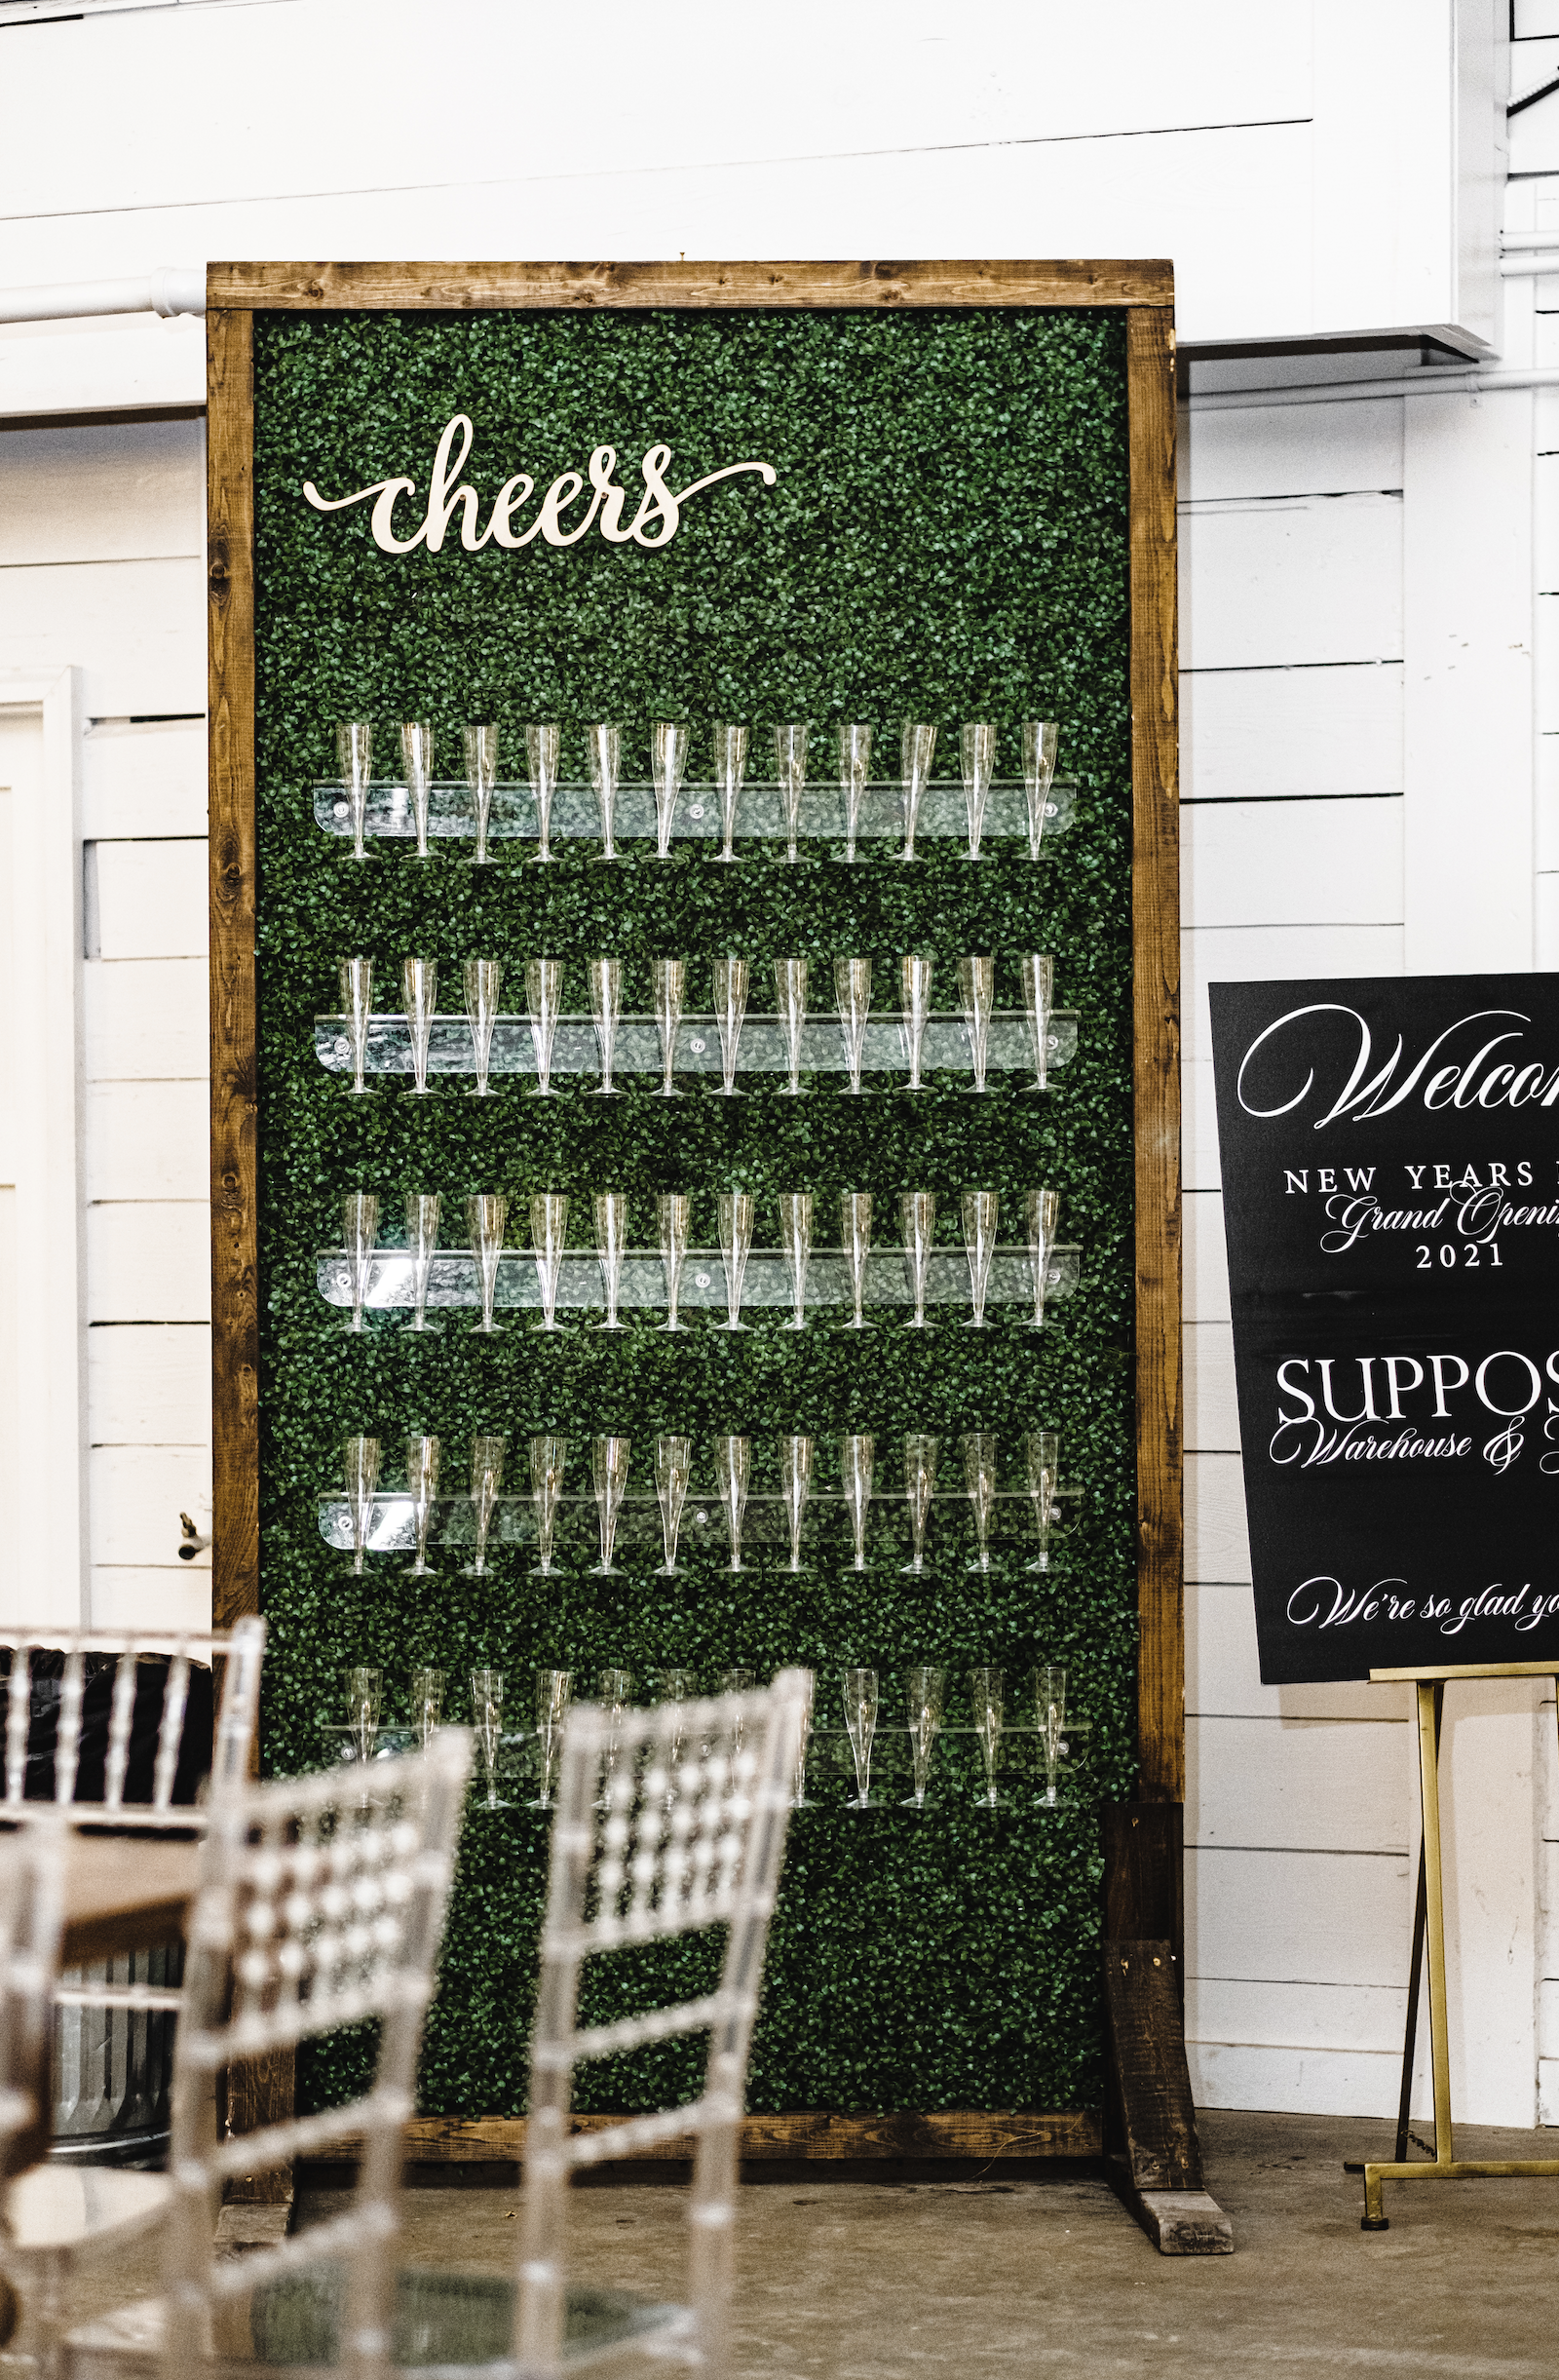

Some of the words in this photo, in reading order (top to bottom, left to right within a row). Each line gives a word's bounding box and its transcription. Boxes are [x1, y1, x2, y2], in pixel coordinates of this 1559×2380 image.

[302, 413, 777, 555] cheers
[1283, 1167, 1377, 1195] NEW
[1404, 1162, 1534, 1190] YEARS
[1319, 1194, 1451, 1253] Grand
[1415, 1243, 1503, 1269] 2021
[1270, 1416, 1472, 1469] Warehouse
[1482, 1415, 1526, 1476] &
[1286, 1576, 1416, 1630] We're
[1420, 1594, 1452, 1619] so
[1440, 1583, 1532, 1635] glad
